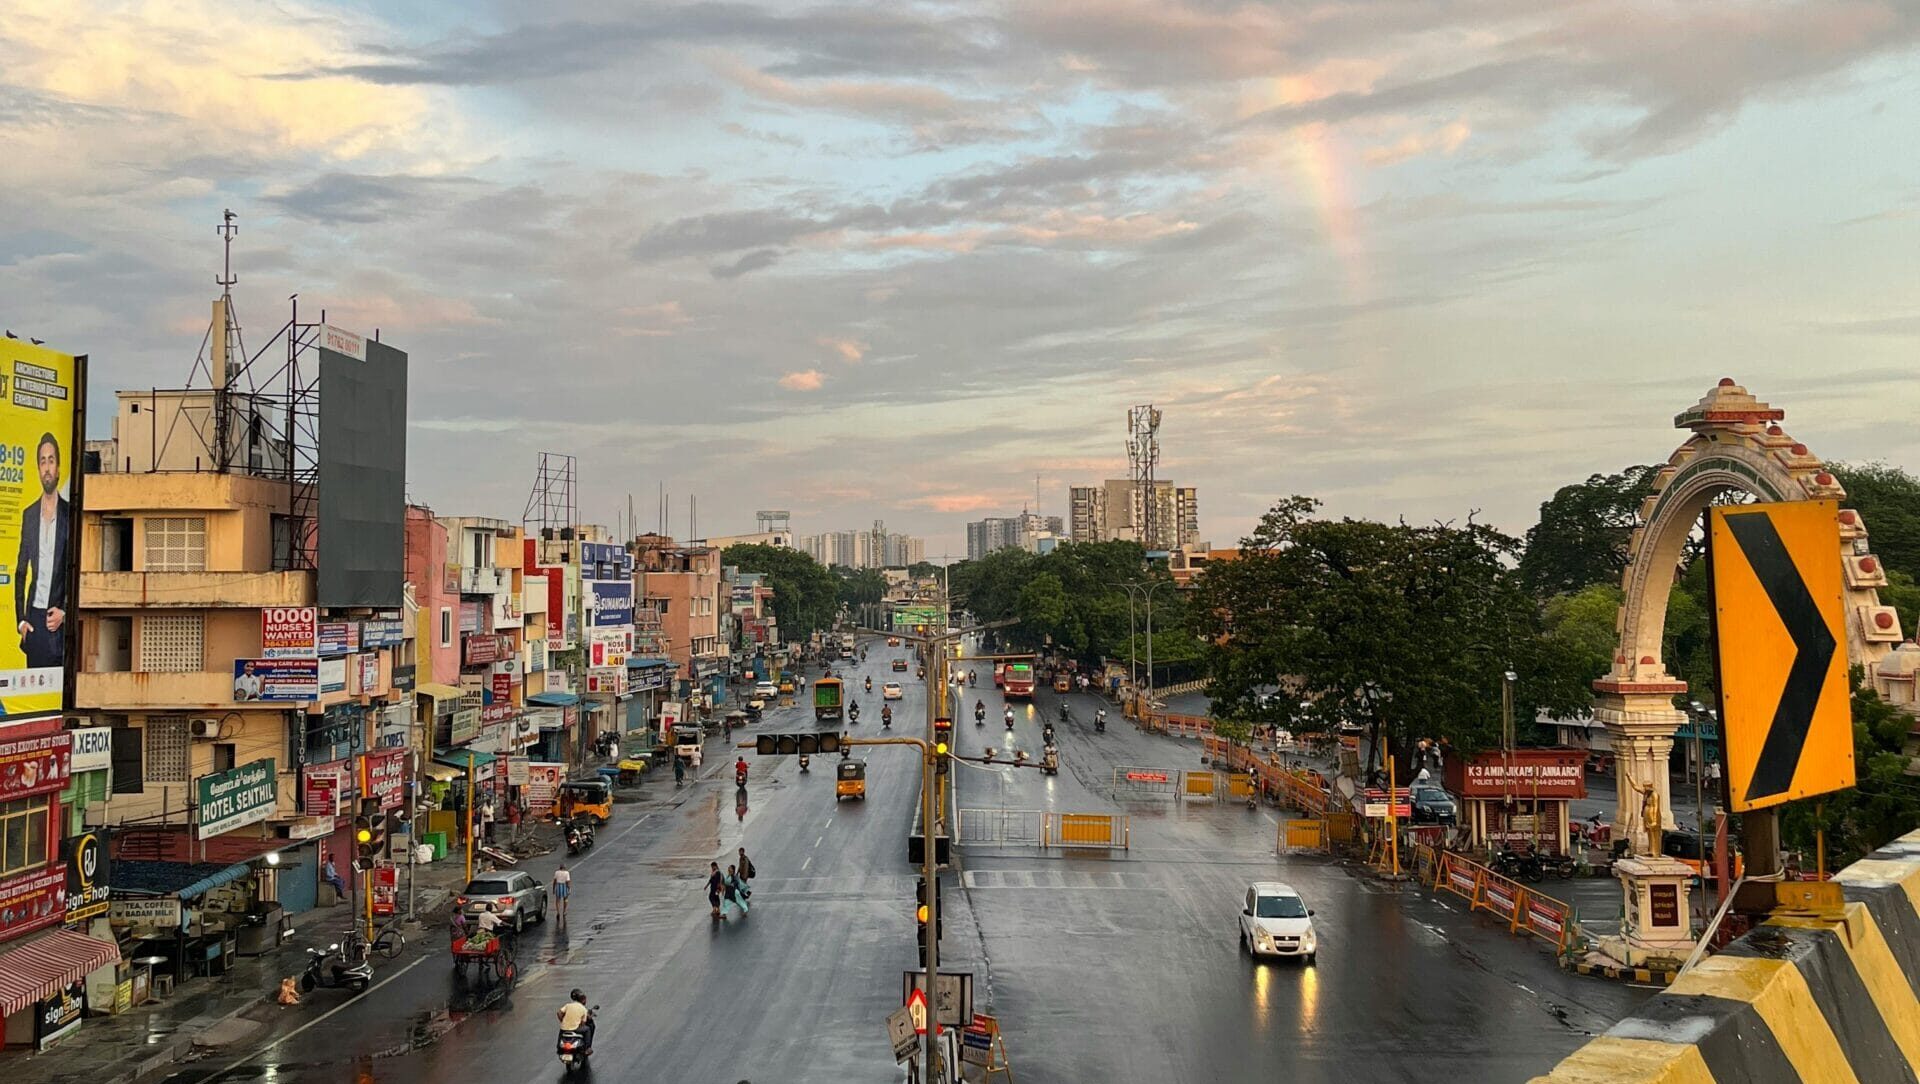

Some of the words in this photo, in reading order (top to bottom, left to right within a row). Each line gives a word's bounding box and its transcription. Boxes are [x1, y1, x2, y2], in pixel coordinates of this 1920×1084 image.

[0, 466, 23, 483] 2024
[264, 608, 313, 623] 1000
[266, 623, 312, 631] NURSE'S
[265, 631, 313, 640] WANTED
[1472, 778, 1494, 786] POLICE
[202, 796, 234, 823] HOTEL
[236, 783, 274, 811] SENTHIL
[144, 901, 175, 910] COFFEE
[125, 909, 153, 918] BADAM
[154, 908, 175, 917] MILK
